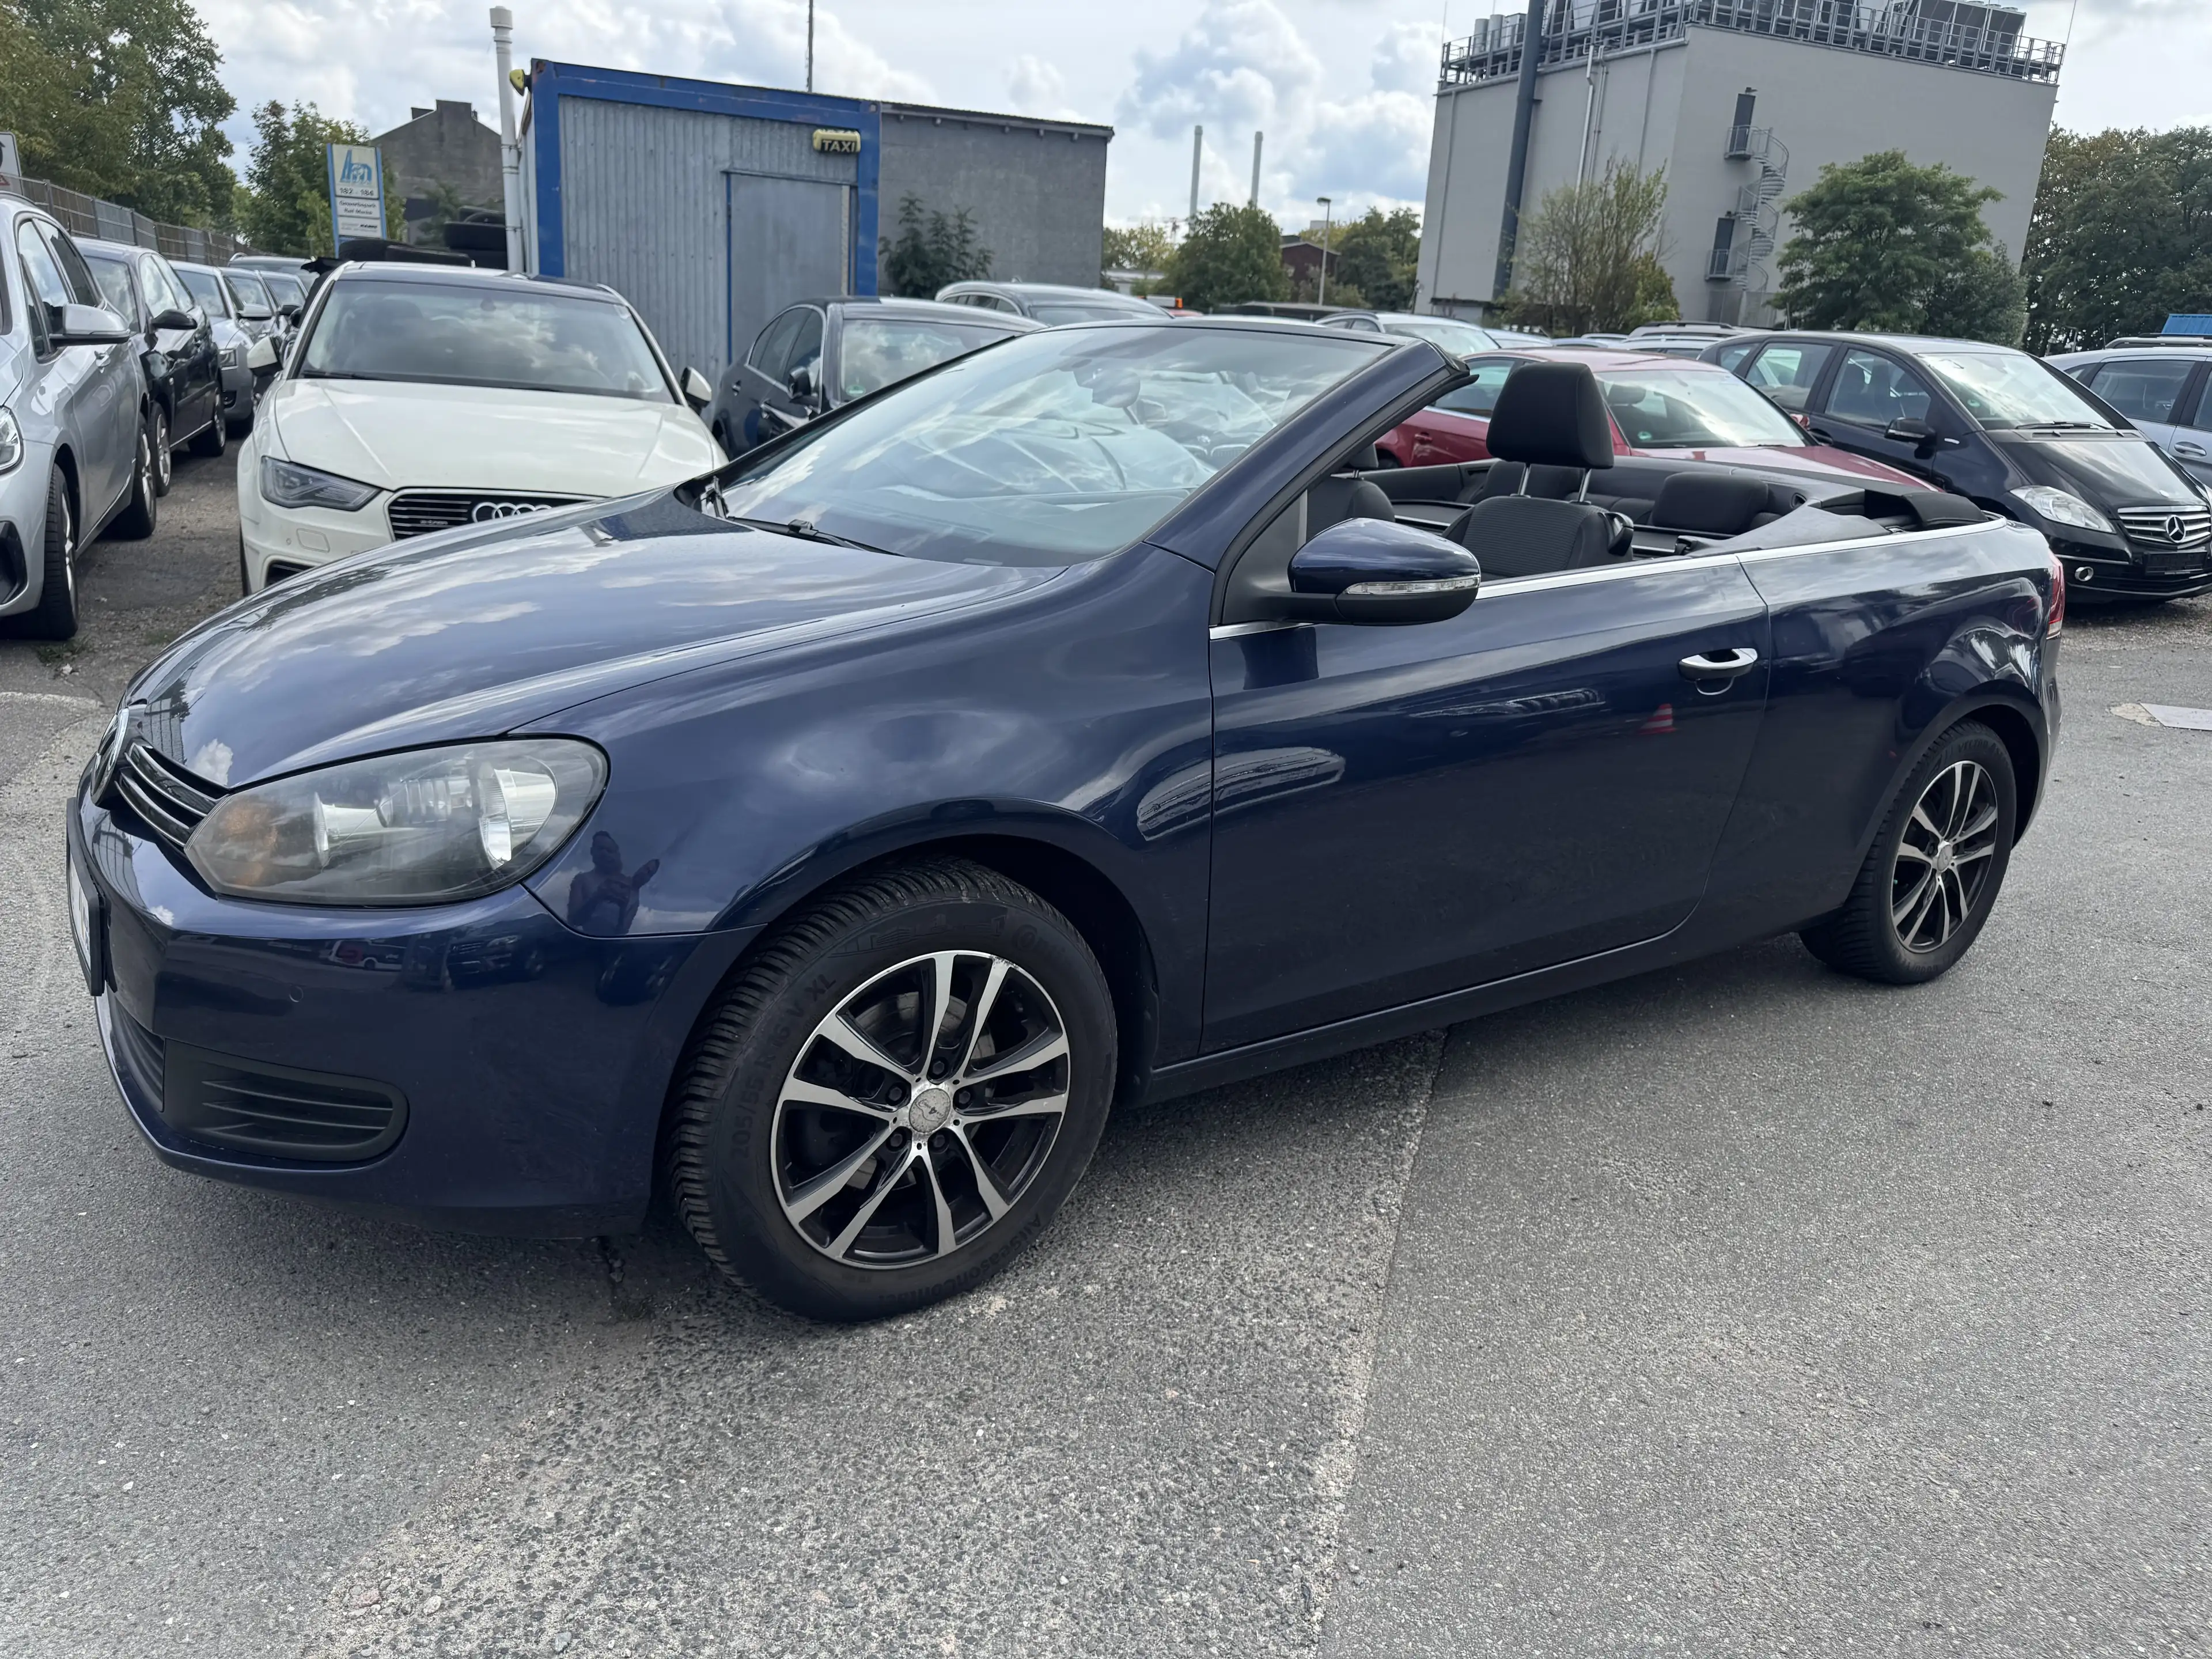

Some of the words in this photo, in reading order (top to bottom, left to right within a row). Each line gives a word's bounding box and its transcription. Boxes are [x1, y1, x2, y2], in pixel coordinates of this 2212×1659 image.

[823, 139, 855, 153] TAXI
[729, 1075, 764, 1160] 205/55
[786, 1000, 807, 1020] V
[804, 973, 836, 1002] XL
